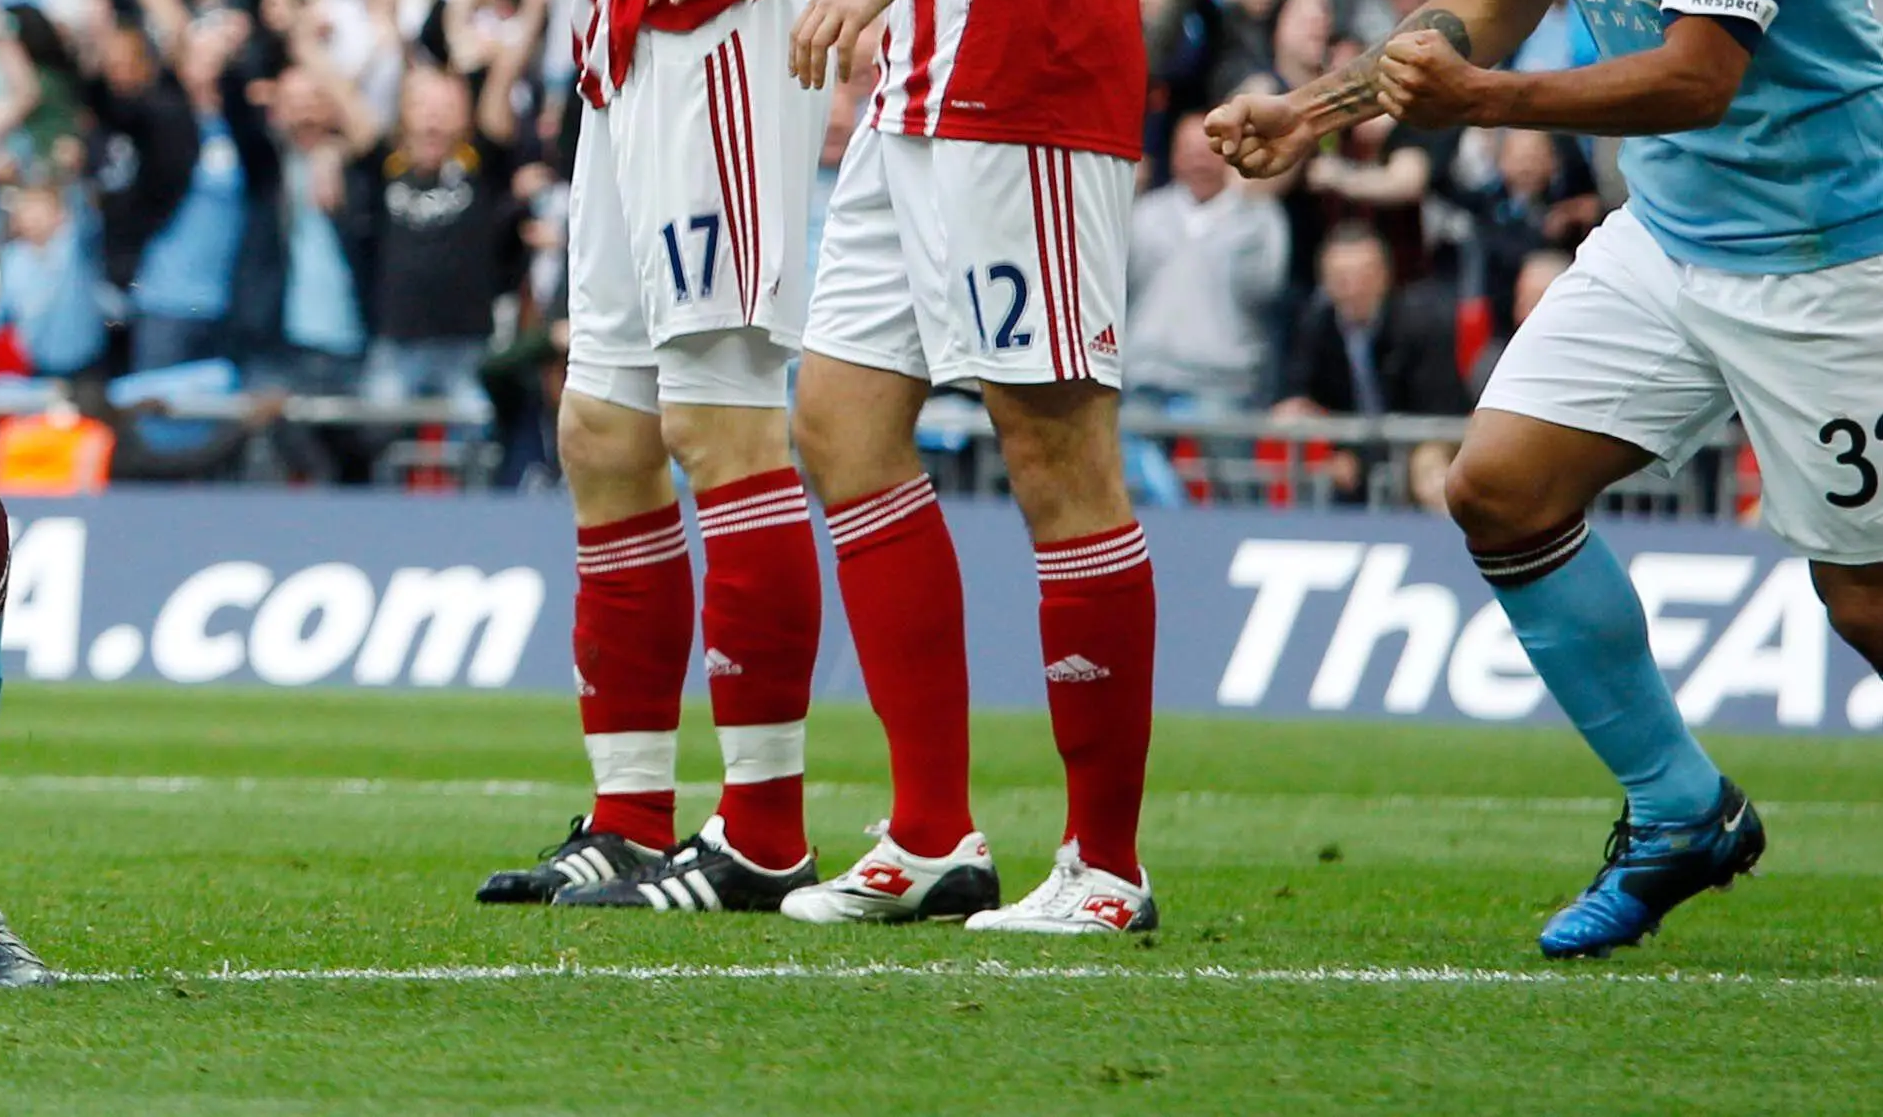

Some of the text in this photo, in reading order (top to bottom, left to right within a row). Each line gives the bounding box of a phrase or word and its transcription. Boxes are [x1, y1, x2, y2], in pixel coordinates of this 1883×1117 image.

[661, 212, 721, 304] 17
[966, 264, 1032, 351] 12
[1819, 417, 1883, 509] 3
